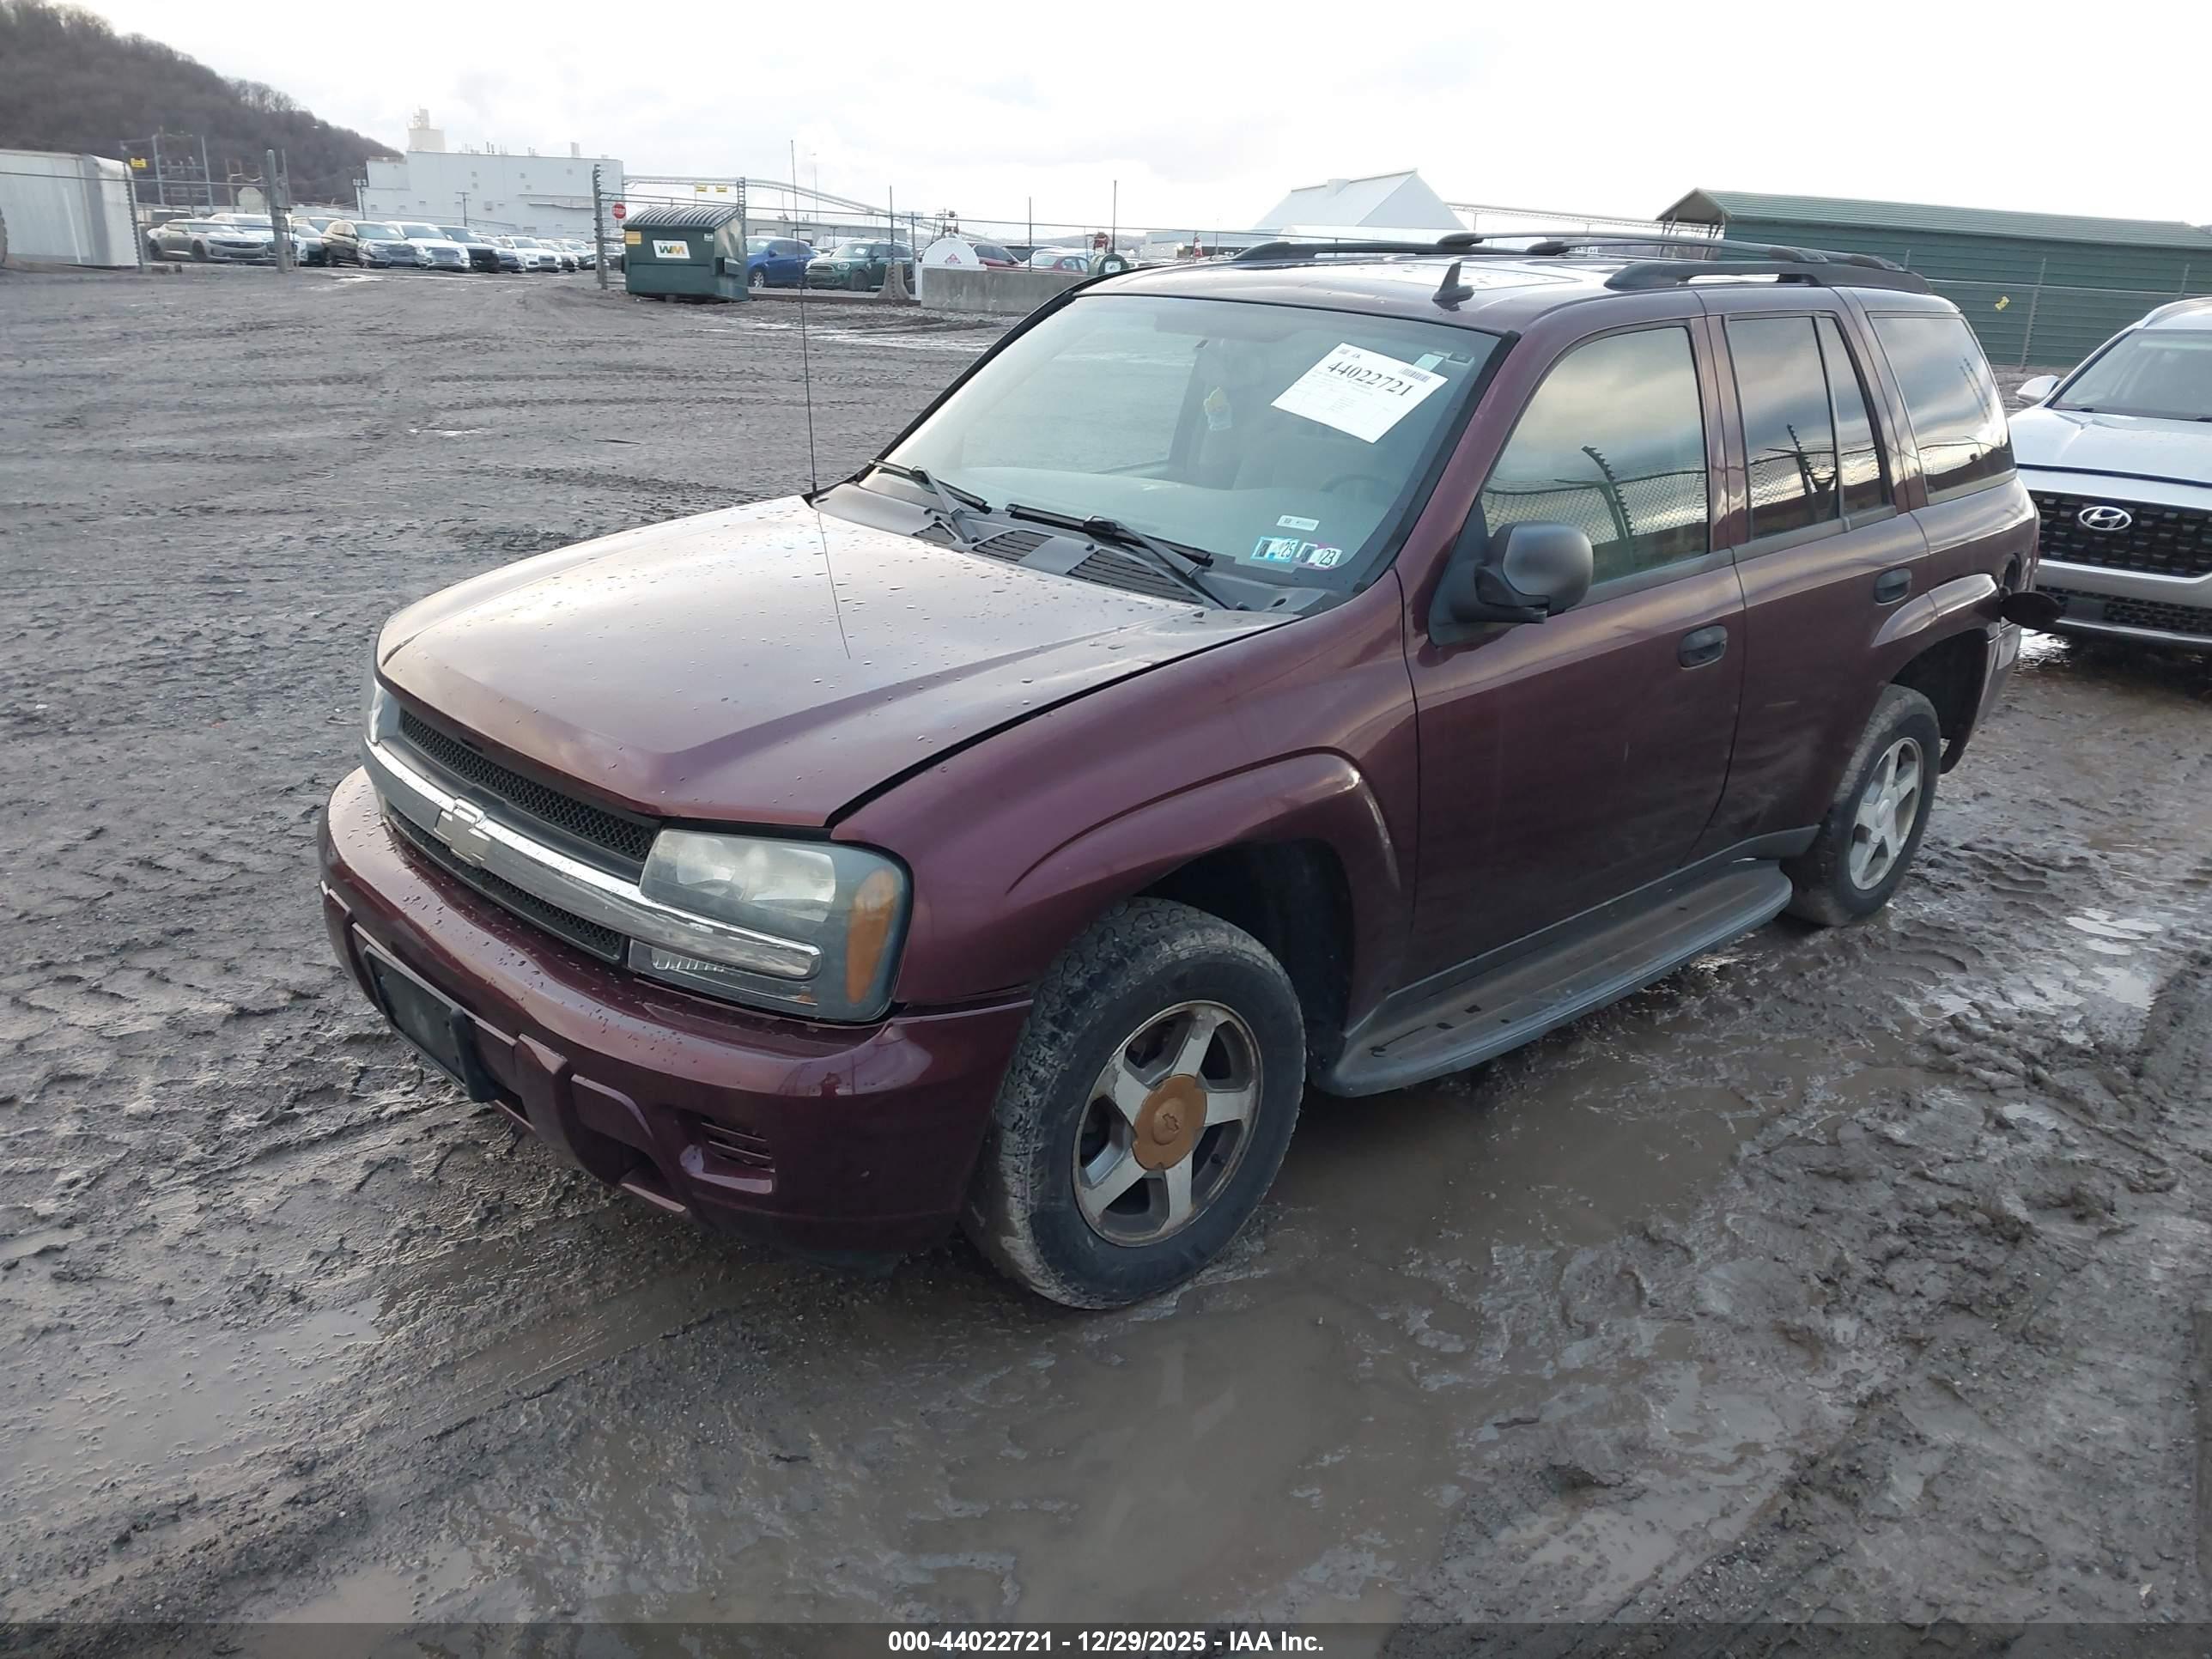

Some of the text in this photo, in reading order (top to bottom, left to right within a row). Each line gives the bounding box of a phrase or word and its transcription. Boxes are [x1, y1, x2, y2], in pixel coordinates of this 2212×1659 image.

[659, 245, 686, 255] WM
[1327, 361, 1415, 396] 44022721
[1280, 541, 1296, 558] 25
[1319, 550, 1337, 566] 23
